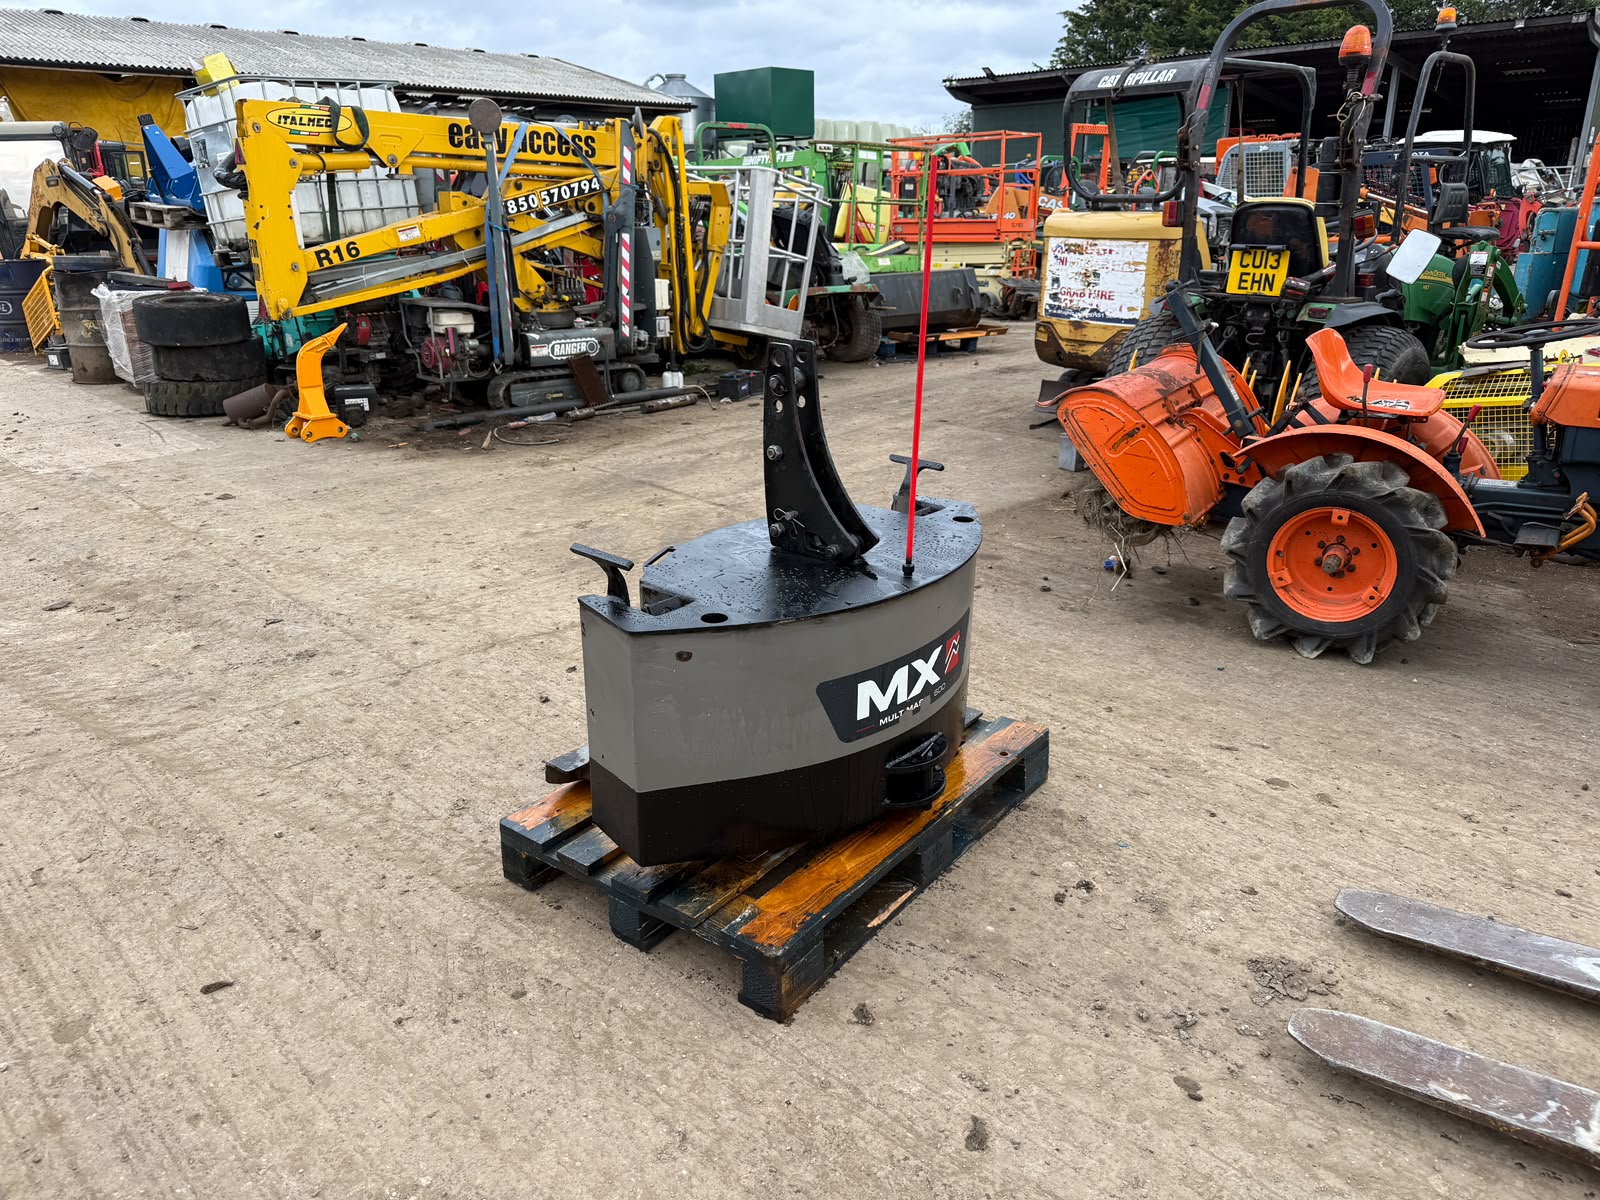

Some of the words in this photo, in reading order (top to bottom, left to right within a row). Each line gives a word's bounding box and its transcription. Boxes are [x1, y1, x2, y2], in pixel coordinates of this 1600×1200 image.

[1097, 69, 1177, 88] CATRPILLAR
[502, 194, 538, 214] 850
[540, 177, 600, 206] 570794
[314, 241, 361, 267] R16
[1239, 250, 1281, 269] CU13
[1237, 272, 1276, 292] EHN
[554, 341, 587, 356] RANGER
[857, 644, 943, 721] MX
